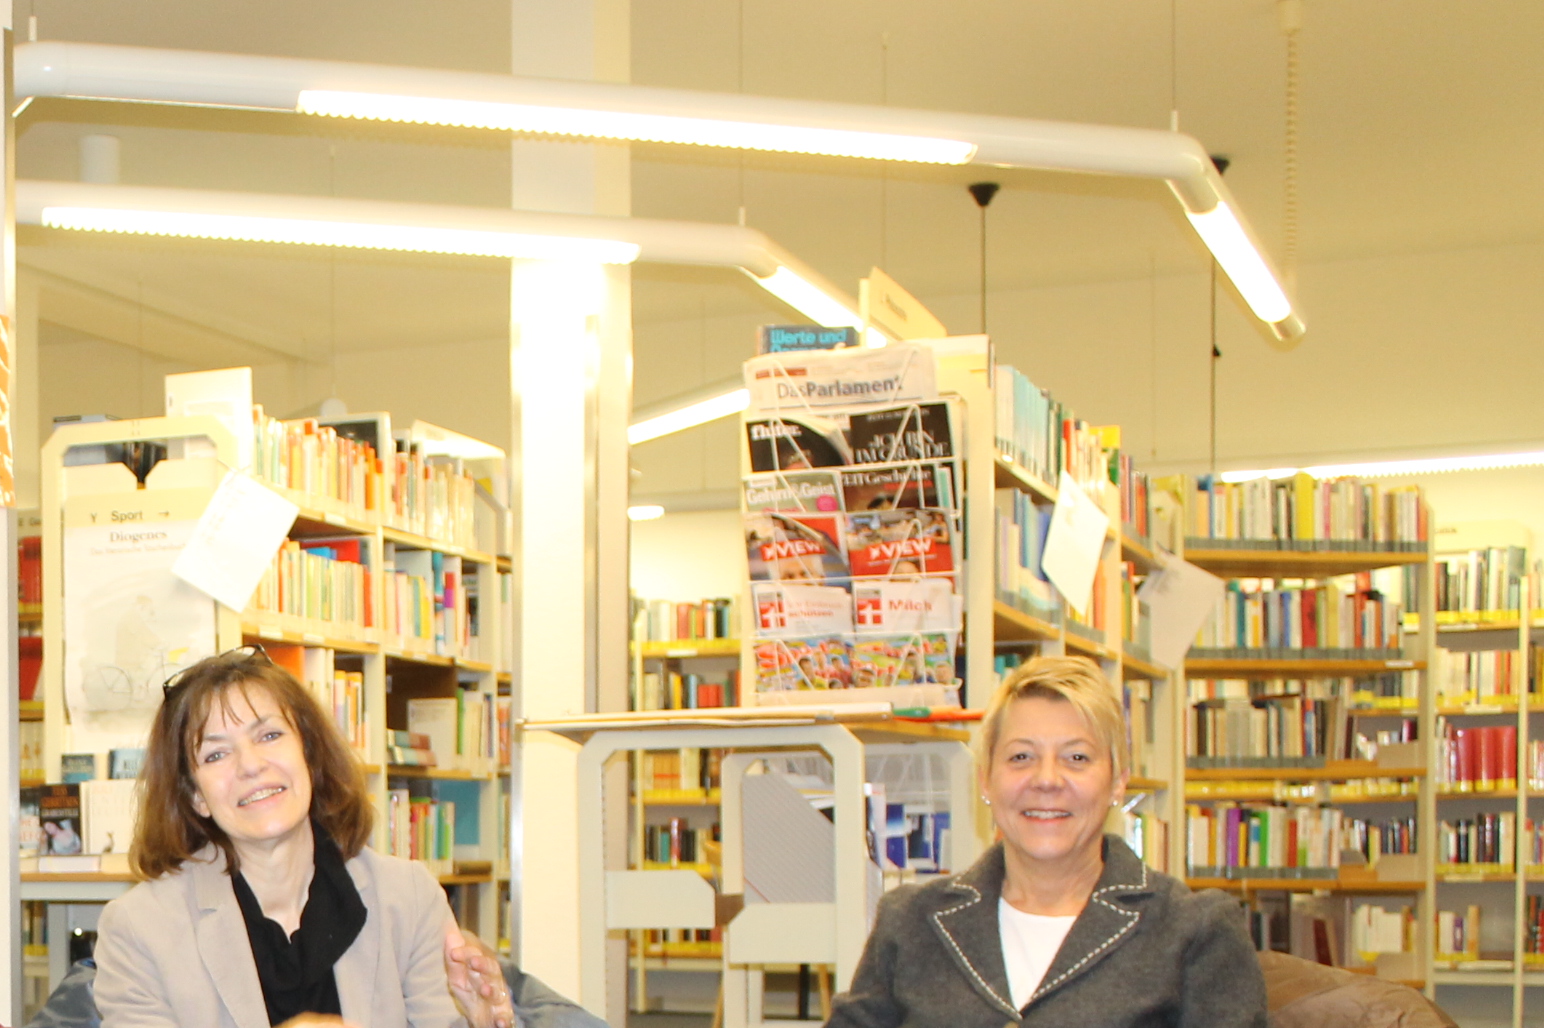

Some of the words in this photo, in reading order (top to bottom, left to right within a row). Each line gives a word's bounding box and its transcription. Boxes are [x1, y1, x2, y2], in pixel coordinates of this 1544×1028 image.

[111, 509, 144, 523] Sport
[109, 529, 168, 543] Diogenes
[889, 598, 933, 611] Milch
